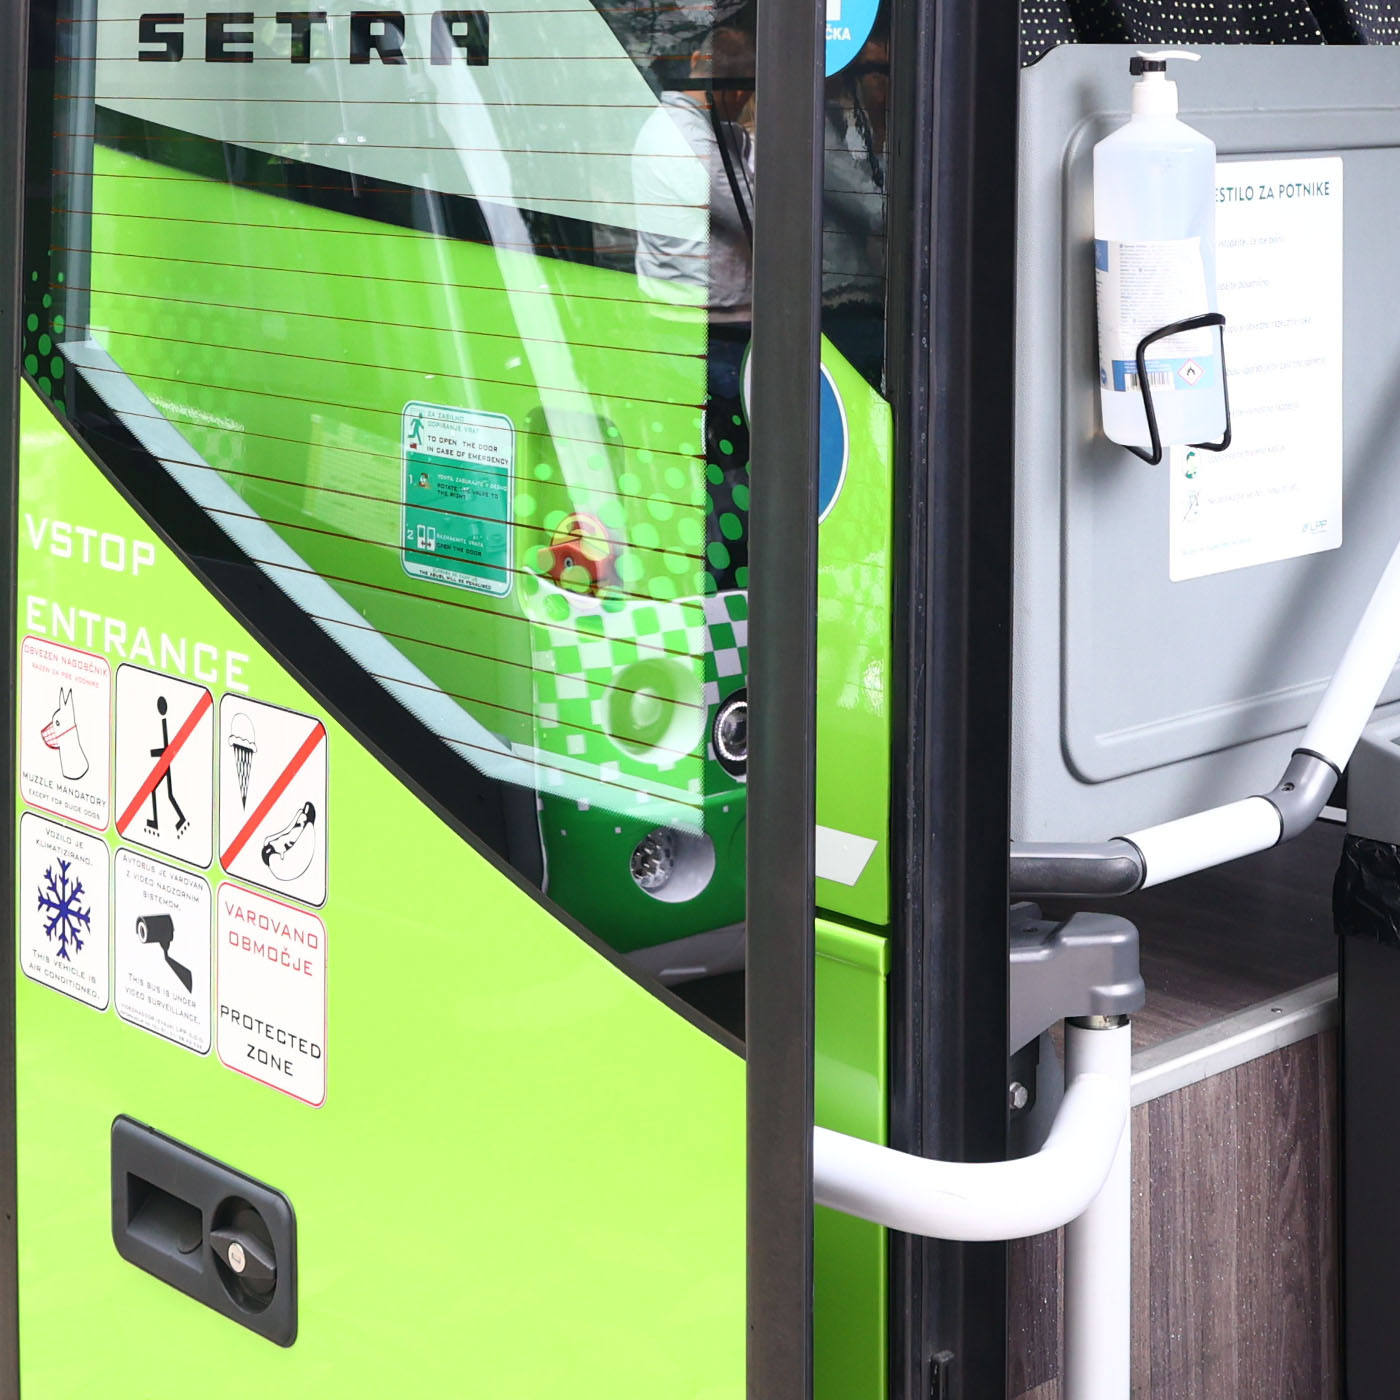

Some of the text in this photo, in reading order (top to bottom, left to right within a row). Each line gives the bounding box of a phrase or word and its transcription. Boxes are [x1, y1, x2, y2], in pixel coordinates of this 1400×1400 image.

[138, 9, 490, 67] SETRA
[1259, 185, 1275, 200] ZA
[1279, 181, 1330, 199] POTNIKE
[427, 435, 498, 452] TO OPEN THE DOOR
[436, 447, 453, 456] CASE
[468, 453, 509, 465] EMERGENCY
[25, 513, 155, 576] VSTOP
[407, 529, 414, 540] 2
[24, 644, 59, 662] OBVEZEN
[26, 595, 250, 692] ENTRANCE
[22, 771, 106, 807] MUZZLE MANDATORY
[29, 788, 100, 820] EXCEPT FOR GUIDE DOGS
[45, 827, 84, 849] VOZILO JE
[123, 854, 203, 891] AVTOBUS JE VAROVAN
[126, 870, 200, 903] Z VIDEO NADZORNIM
[225, 900, 318, 950] VAROVANO
[32, 949, 97, 984] THIS VEHICLE IS
[229, 930, 313, 976] OBMOČJE
[29, 962, 100, 999] AIR CONDITIONED.
[128, 972, 197, 1008] THIS BUS IS UNDER
[125, 987, 201, 1025] VIDEO SURVEILLANCE.
[220, 1004, 321, 1059] PROTECTED
[247, 1043, 294, 1077] ZONE
